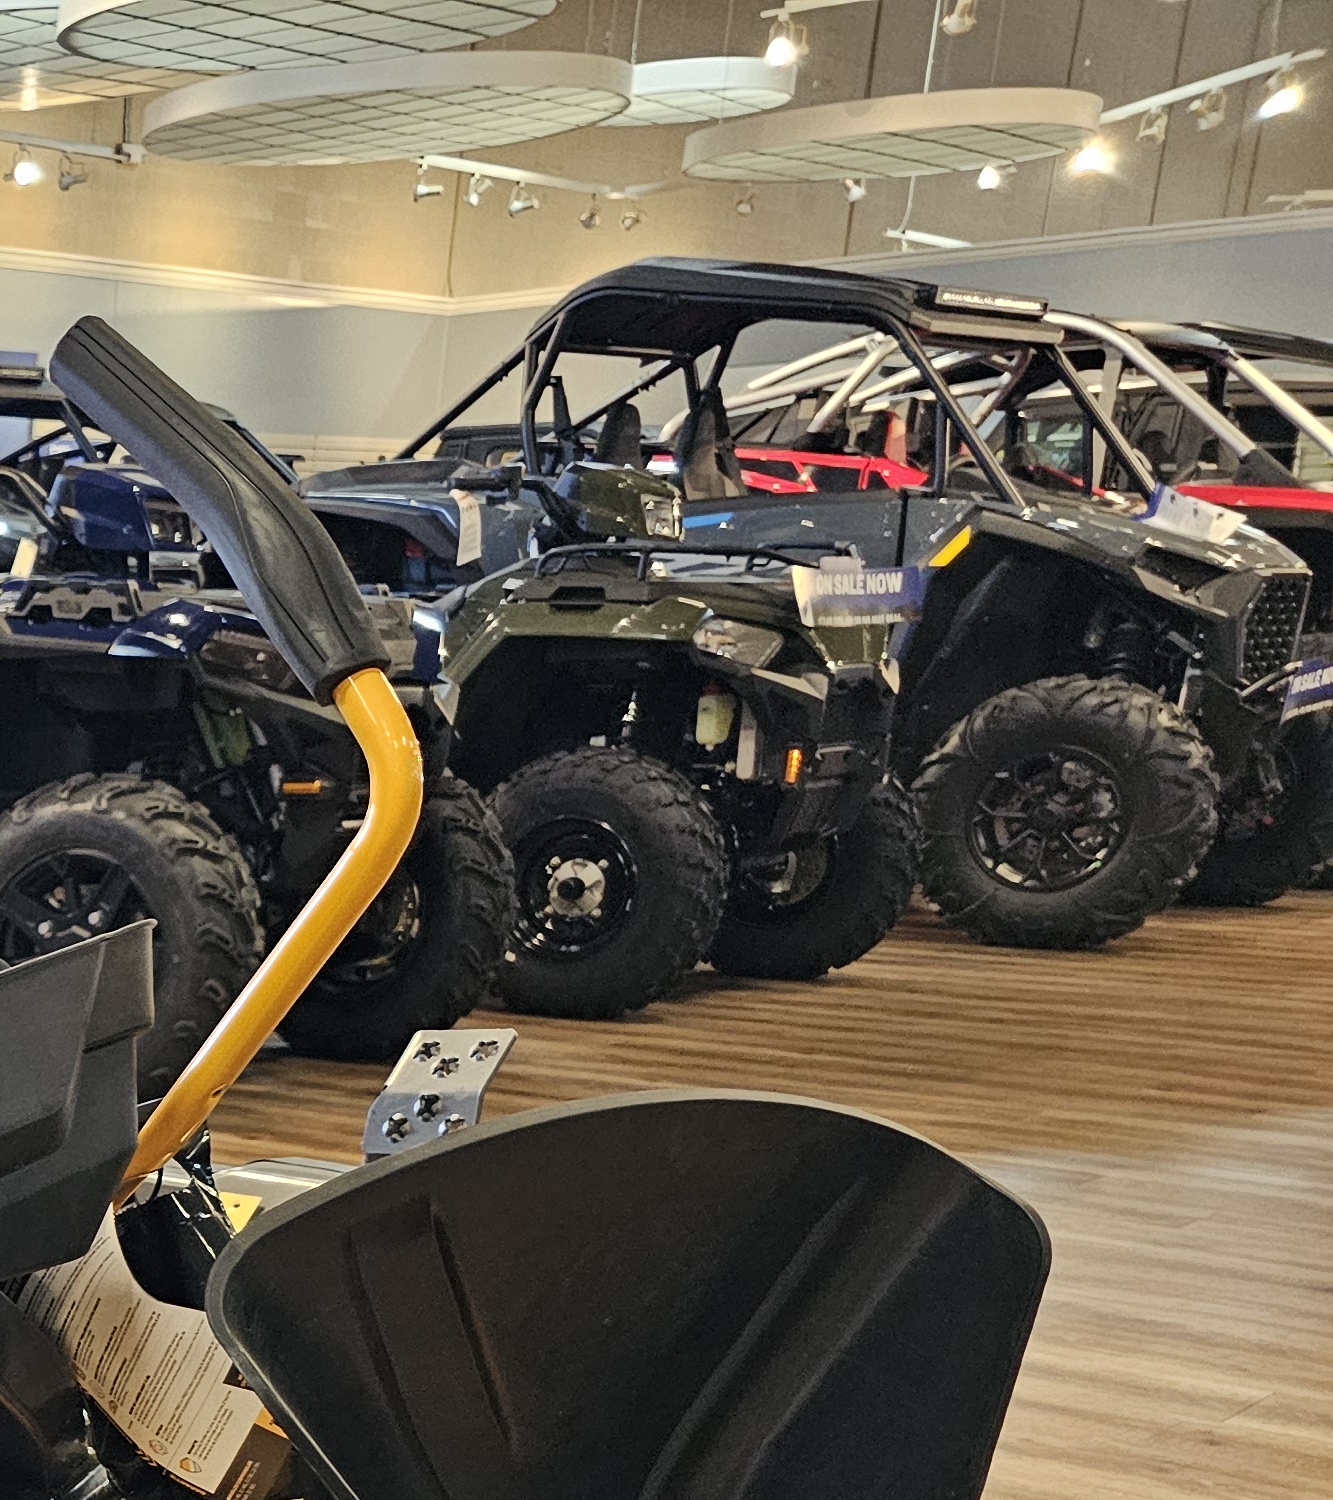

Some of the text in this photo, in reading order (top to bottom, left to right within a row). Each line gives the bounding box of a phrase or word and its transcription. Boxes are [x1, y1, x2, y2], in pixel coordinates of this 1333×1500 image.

[815, 572, 904, 596] ON SALE NOW
